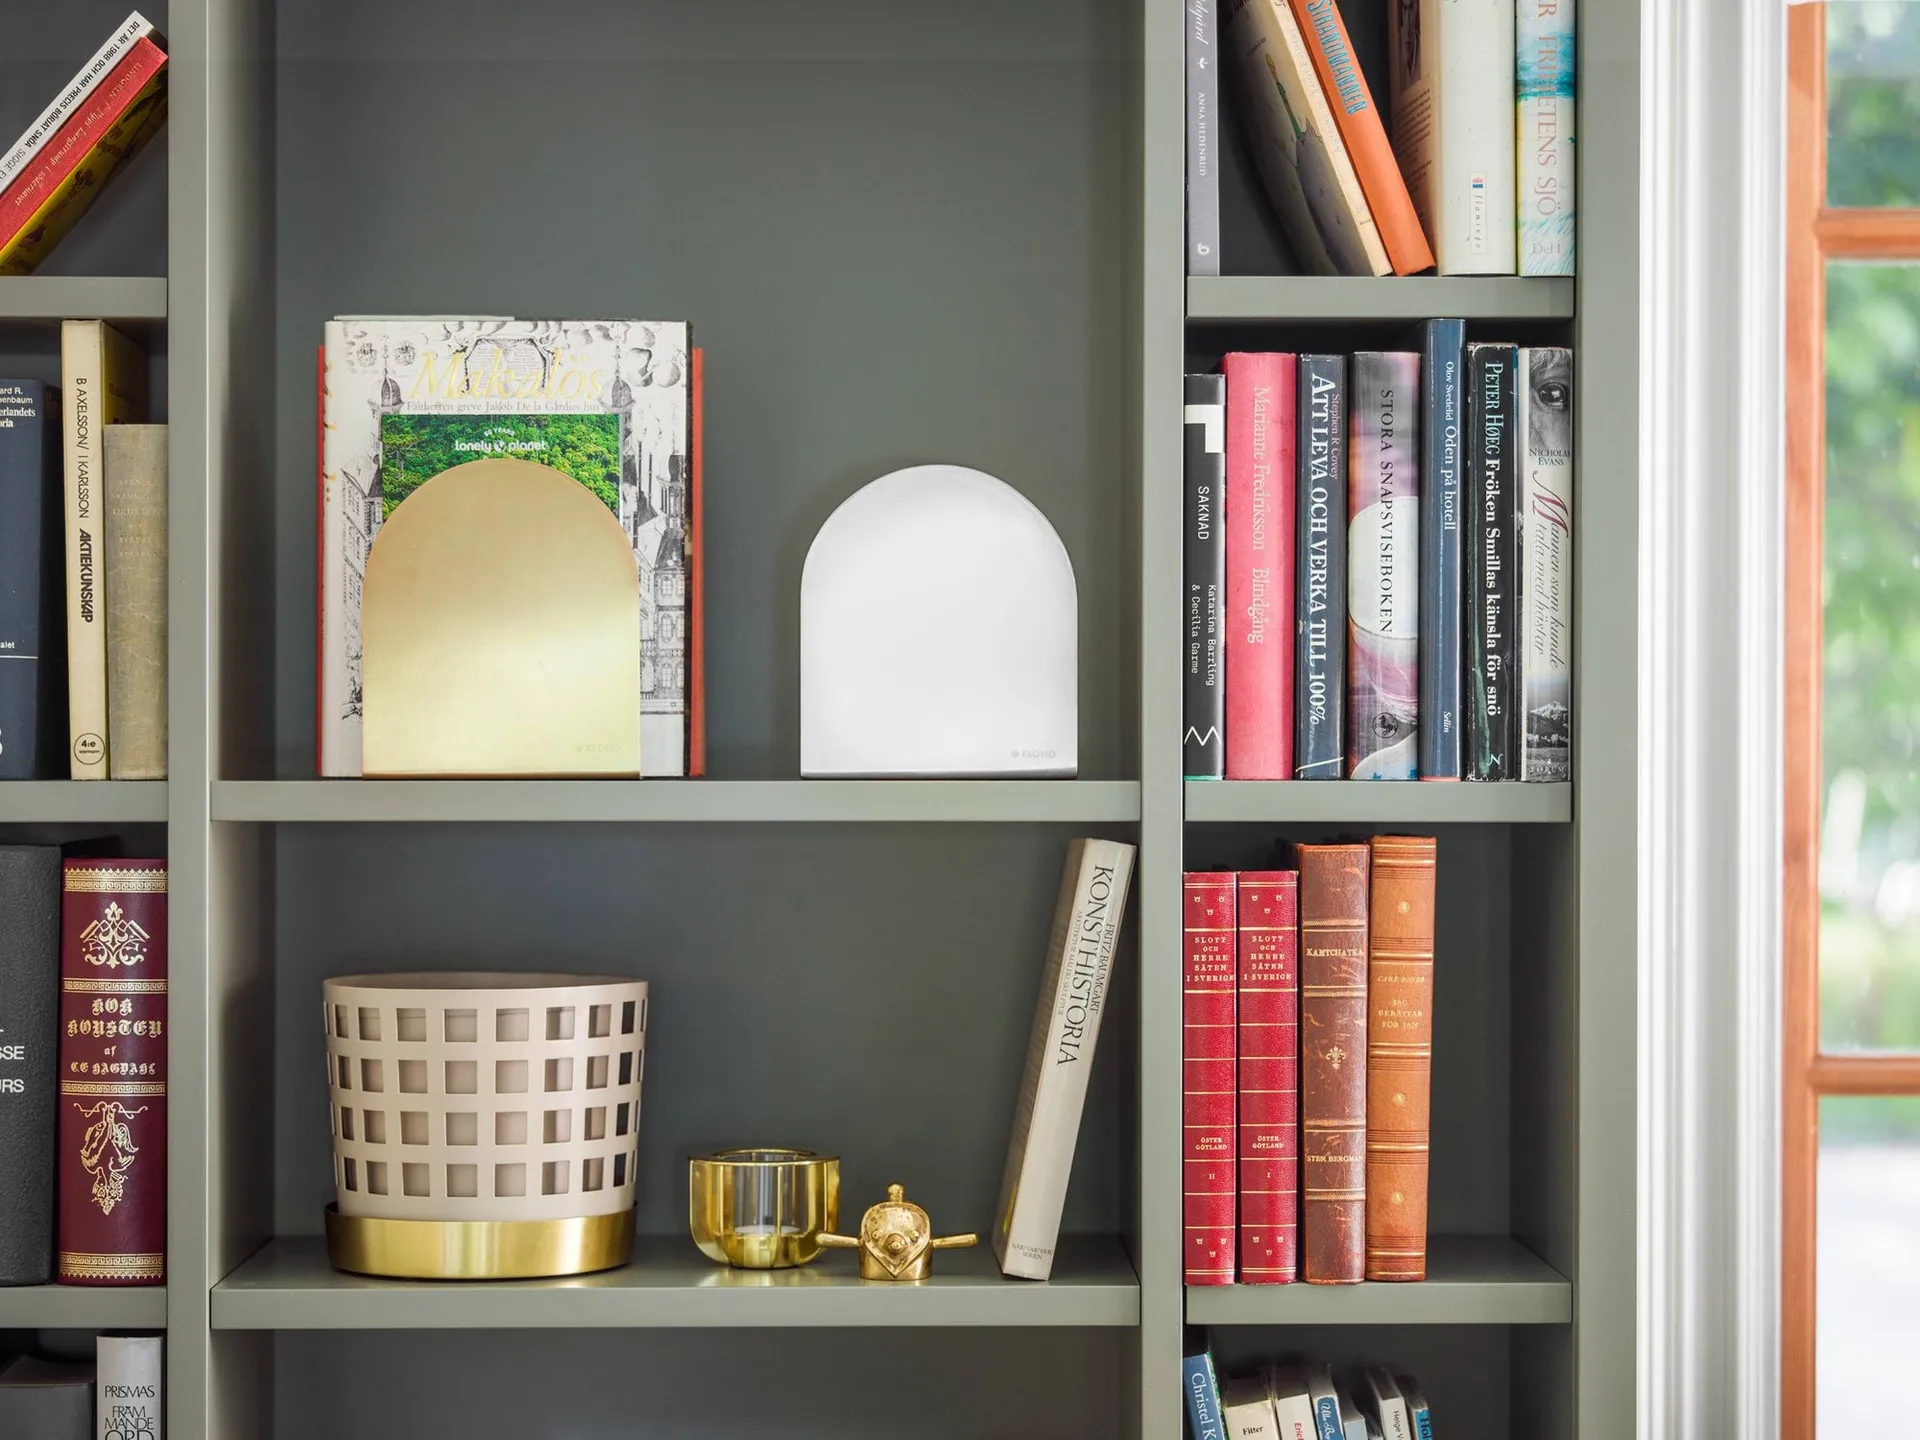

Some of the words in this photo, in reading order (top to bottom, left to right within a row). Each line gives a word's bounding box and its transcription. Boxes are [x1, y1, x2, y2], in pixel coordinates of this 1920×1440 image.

[1538, 0, 1557, 18] R
[118, 34, 130, 46] ÄR
[127, 21, 141, 36] DET
[92, 60, 107, 76] OCH
[104, 44, 121, 62] 1988
[1306, 0, 1367, 115] STRANDMANNEN
[80, 73, 94, 89] HAR
[110, 62, 144, 98] LINDGREN
[60, 86, 83, 111] PRECIS
[1538, 36, 1556, 166] FRIHETENS
[40, 108, 63, 133] BÖRJAT
[84, 107, 105, 128] Pippi
[25, 130, 44, 150] SNÖA
[4, 148, 27, 173] SIGGE
[14, 172, 46, 206] söderhavet
[1535, 177, 1561, 216] SJÖ
[408, 347, 606, 400] Makalös
[1445, 361, 1454, 383] Olov
[1485, 362, 1503, 409] PETER
[458, 404, 482, 414] greve
[484, 401, 513, 412] Jakob
[516, 402, 530, 412] De
[534, 401, 542, 412] la
[583, 401, 600, 412] hus
[1312, 374, 1336, 422] ATT
[1330, 393, 1340, 434] Stephen
[1445, 384, 1454, 420] Svedelid
[1254, 387, 1271, 460] Marianne
[1380, 390, 1394, 451] STORA
[1486, 414, 1504, 455] HØEG
[454, 440, 492, 453] lonely
[508, 440, 546, 452] planet
[1311, 427, 1328, 481] LEVA
[1331, 437, 1340, 445] R
[1528, 448, 1570, 458] NICHOLAS
[1330, 449, 1340, 480] Covey
[1440, 470, 1456, 486] på
[1538, 457, 1564, 466] EVANS
[78, 461, 89, 518] KARLSSON
[1252, 464, 1271, 550] Fredriksson
[1486, 458, 1500, 522] Fröken
[1198, 486, 1209, 540] SAKNAD
[1310, 487, 1328, 533] OCH
[1444, 491, 1456, 530] hotell
[1380, 461, 1394, 632] SNAPSVISEBOKEN
[1486, 528, 1500, 588] Smillas
[1535, 522, 1551, 558] tala
[80, 528, 93, 623] AKTIEKUNSKAP
[1310, 539, 1328, 614] VERKA
[1536, 562, 1550, 601] med
[1208, 584, 1216, 634] Katarina
[1248, 568, 1270, 644] Blindgång
[1550, 576, 1559, 612] som
[1192, 596, 1200, 638] Cecilia
[1486, 594, 1500, 648] känsla
[1534, 600, 1550, 656] hästar
[1191, 643, 1200, 674] Garme
[1308, 620, 1326, 667] TILL
[1549, 617, 1564, 668] kunde
[1206, 639, 1216, 686] Barrling
[1487, 654, 1500, 681] för
[1309, 672, 1326, 725] 100%
[1487, 686, 1500, 716] snö
[1443, 711, 1452, 732] Sellin
[1102, 924, 1115, 954] FRITZ
[1306, 949, 1363, 957] KAMTCHATKA
[1057, 865, 1114, 1066] KONSTHISTORIA
[1090, 954, 1108, 1014] BAUMGART
[92, 998, 132, 1016] KOK
[1382, 1020, 1400, 1028] FÖR
[1403, 1021, 1418, 1029] JAN
[68, 1019, 162, 1038] KONSTEN
[0, 1046, 24, 1060] SE
[0, 1078, 24, 1093] RS
[105, 1386, 154, 1398] PRISMAS
[1192, 1372, 1214, 1424] Christel
[1203, 1427, 1218, 1440] K
[104, 1417, 154, 1430] MANDE
[1242, 1426, 1264, 1436] Fitter
[1393, 1410, 1402, 1432] Helge
